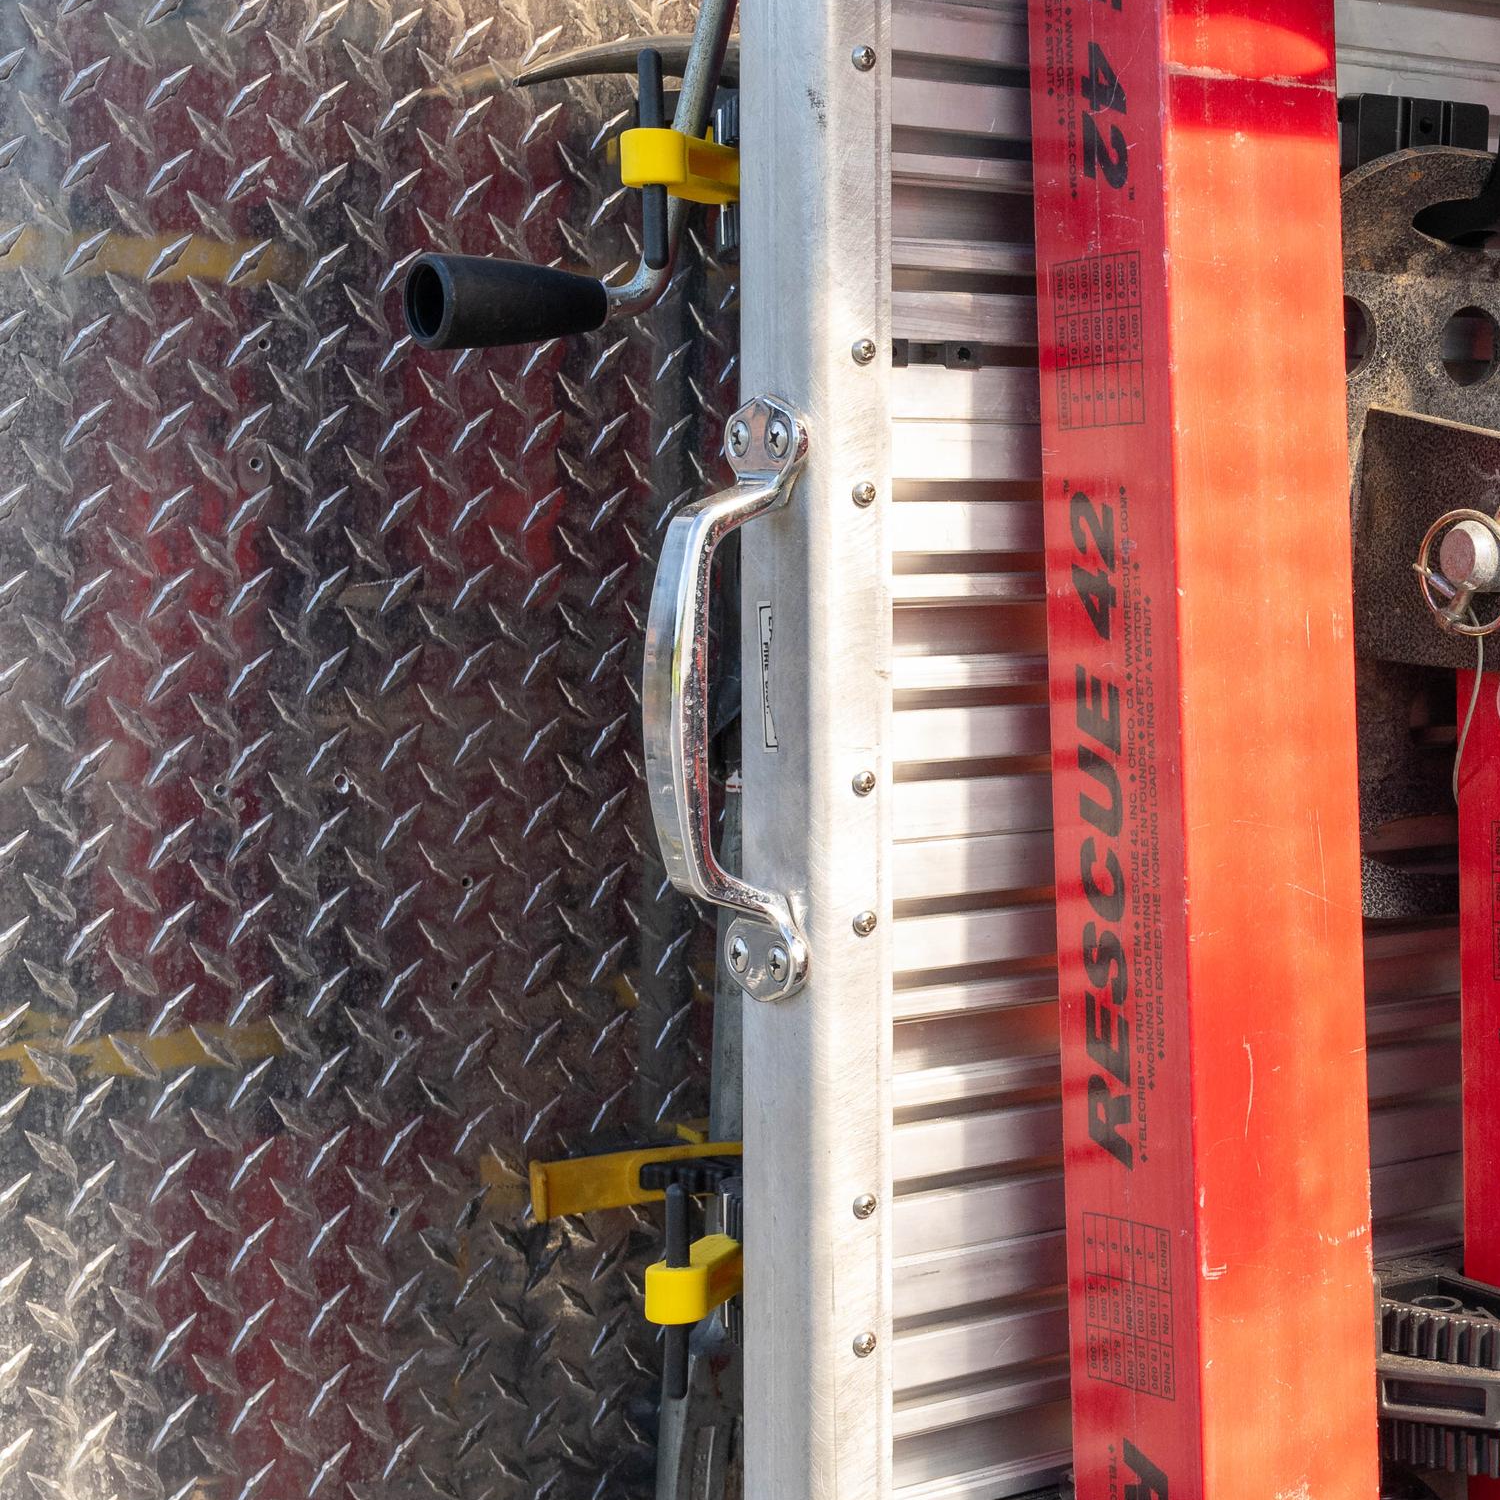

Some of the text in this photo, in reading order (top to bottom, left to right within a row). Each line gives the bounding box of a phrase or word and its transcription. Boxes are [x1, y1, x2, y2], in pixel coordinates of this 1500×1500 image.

[1056, 28, 1064, 88] FACTOR
[1133, 600, 1142, 662] FACTOR
[1126, 687, 1134, 709] CA
[1135, 665, 1145, 727] SAFETY
[1138, 746, 1147, 814] POUNDS
[1142, 607, 1165, 1048] NEVER EXCEED THE WORKING LOAD RATING OF A STRUT
[1131, 852, 1140, 915] RESCUE
[1141, 838, 1149, 886] TABLE
[1076, 665, 1133, 1170] RESCUE
[1143, 892, 1151, 952] RATING
[1133, 934, 1142, 998] SYSTEM
[1144, 955, 1153, 996] LOAD
[1135, 1006, 1144, 1054] STRUT
[1146, 1001, 1155, 1080] WORKING
[1160, 1233, 1171, 1395] LENGTH PIN PINS
